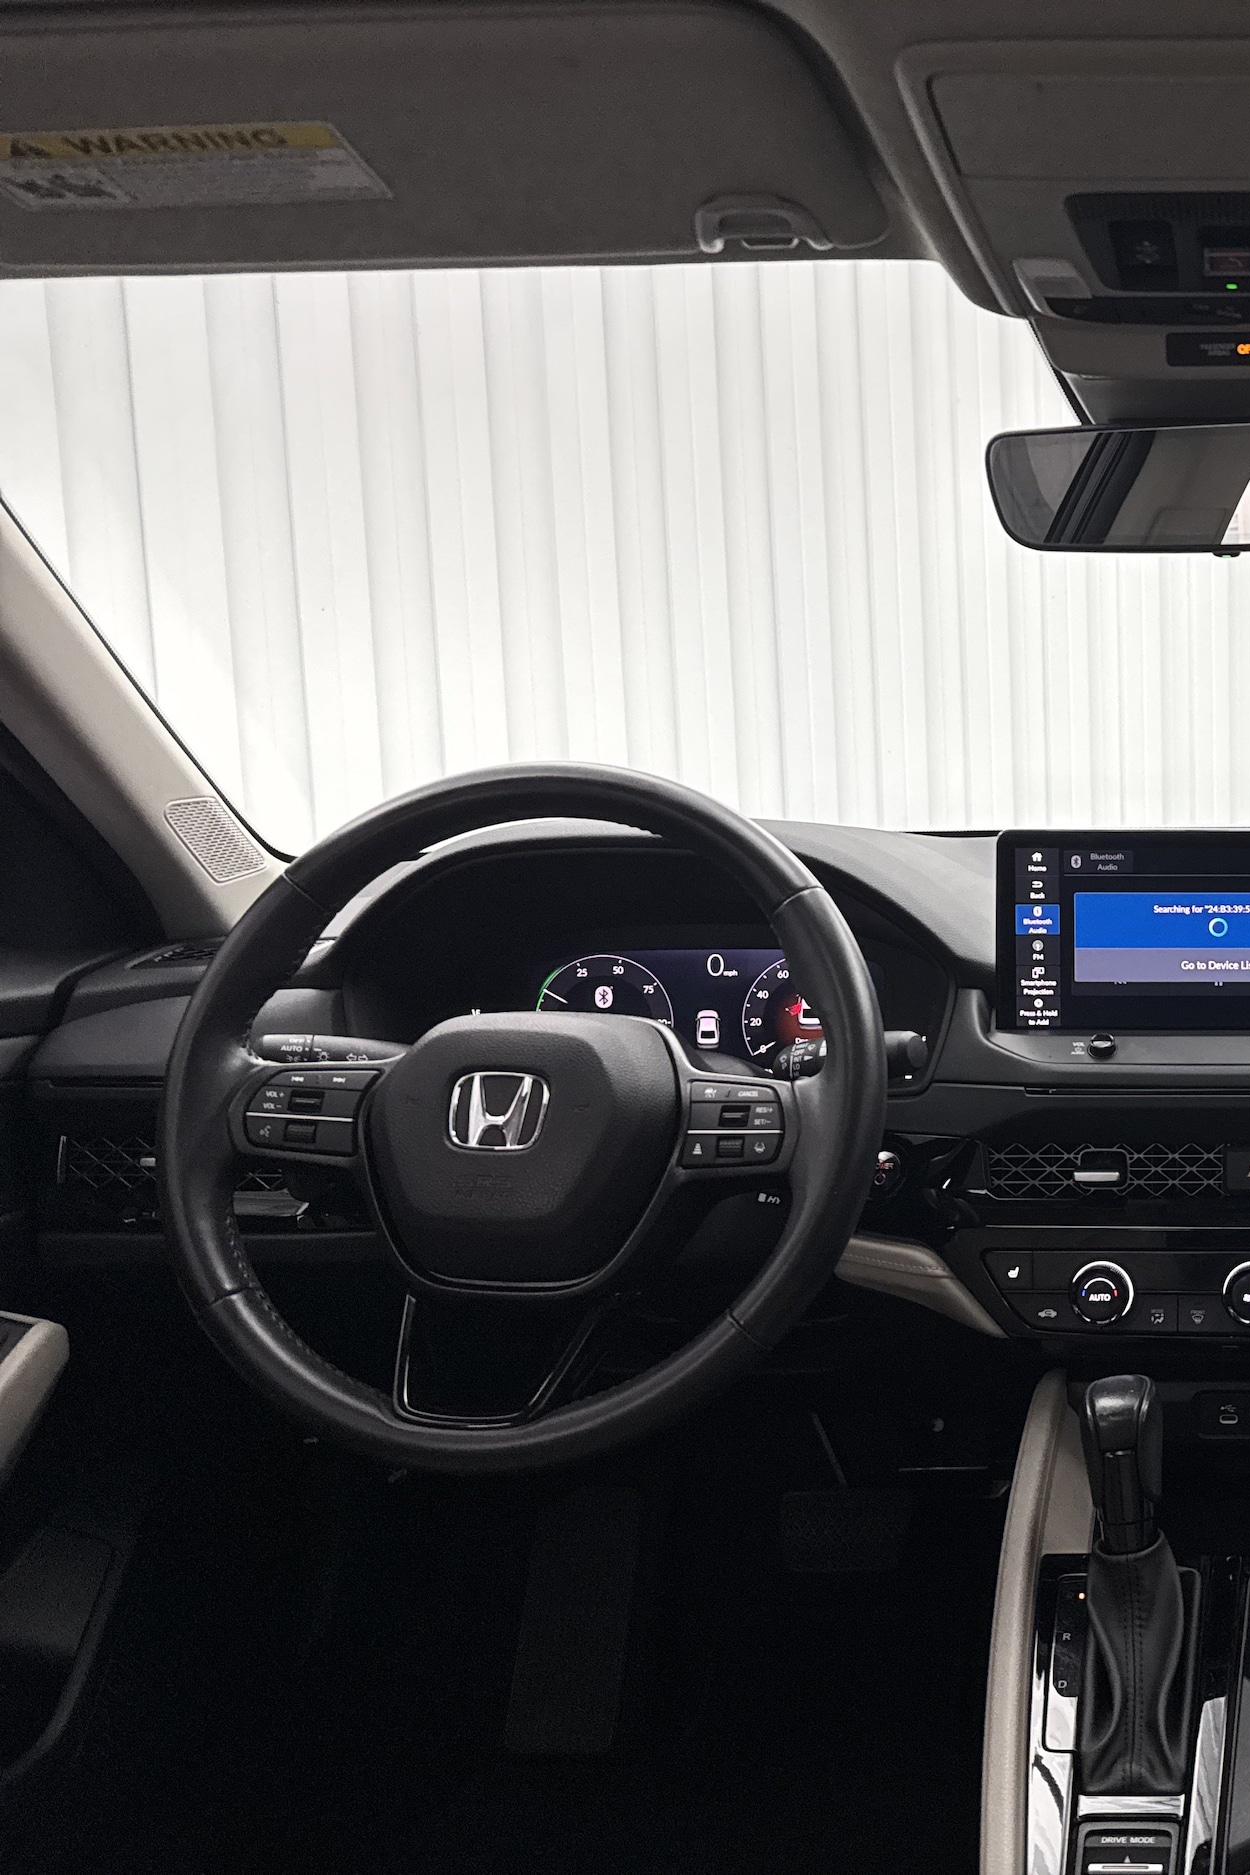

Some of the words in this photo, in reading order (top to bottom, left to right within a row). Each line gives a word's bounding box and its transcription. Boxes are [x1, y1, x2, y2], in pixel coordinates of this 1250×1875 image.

[62, 128, 289, 155] WARNING
[1153, 905, 1191, 915] Searching
[1191, 905, 1203, 913] for
[1022, 918, 1053, 926] Bluetooth
[706, 953, 724, 977] 0
[723, 969, 739, 977] mph
[1181, 960, 1196, 970] Go
[1196, 961, 1206, 970] to
[1208, 960, 1239, 970] Device
[576, 968, 588, 977] 25
[612, 966, 624, 975] 50
[777, 970, 789, 979] 60
[1020, 979, 1057, 987] Smartphone
[643, 985, 654, 994] 75
[1023, 988, 1054, 996] Projection
[756, 990, 769, 999] 40
[750, 1018, 762, 1026] 20
[1089, 1293, 1111, 1301] AUTO
[1062, 1632, 1072, 1641] R
[1058, 1679, 1068, 1689] D
[1101, 1836, 1128, 1844] DRIVE
[1129, 1836, 1156, 1844] MODE
